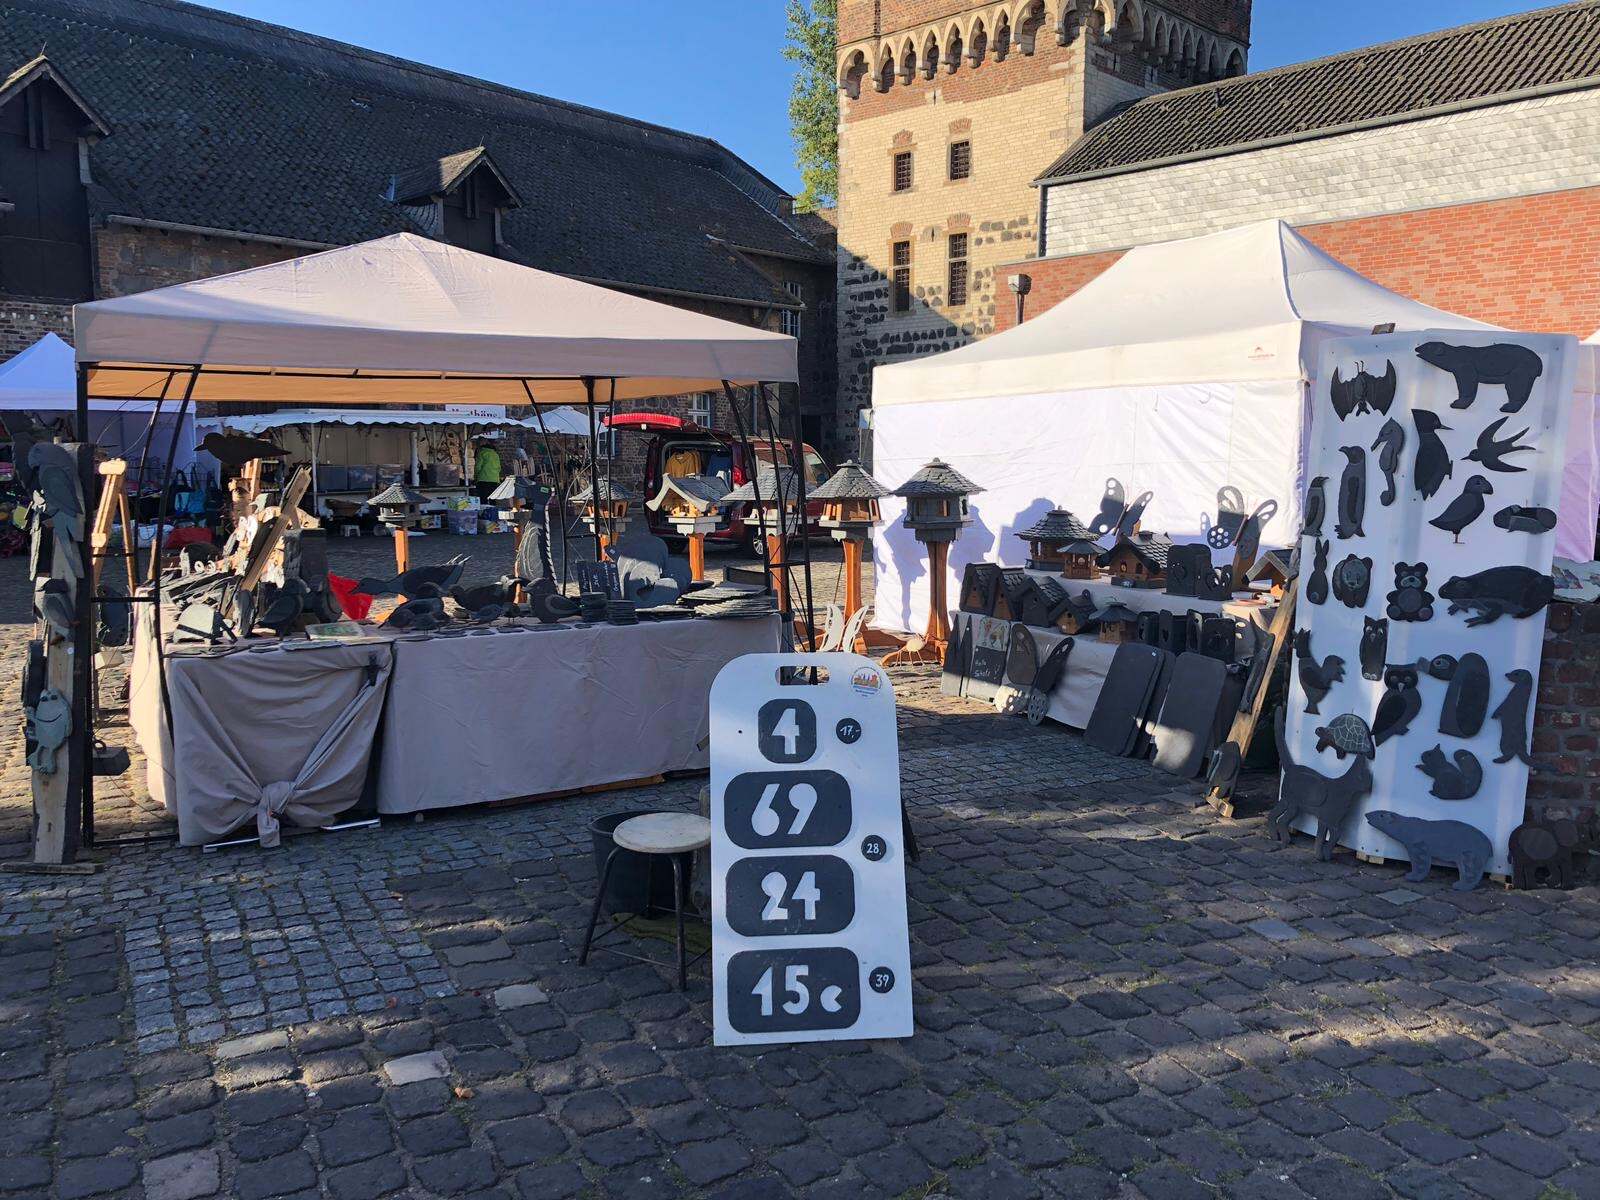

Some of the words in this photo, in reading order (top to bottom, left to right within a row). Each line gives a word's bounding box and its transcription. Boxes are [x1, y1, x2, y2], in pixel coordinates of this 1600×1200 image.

[771, 707, 799, 755] 4
[751, 783, 818, 837] 69
[761, 871, 821, 921] 24
